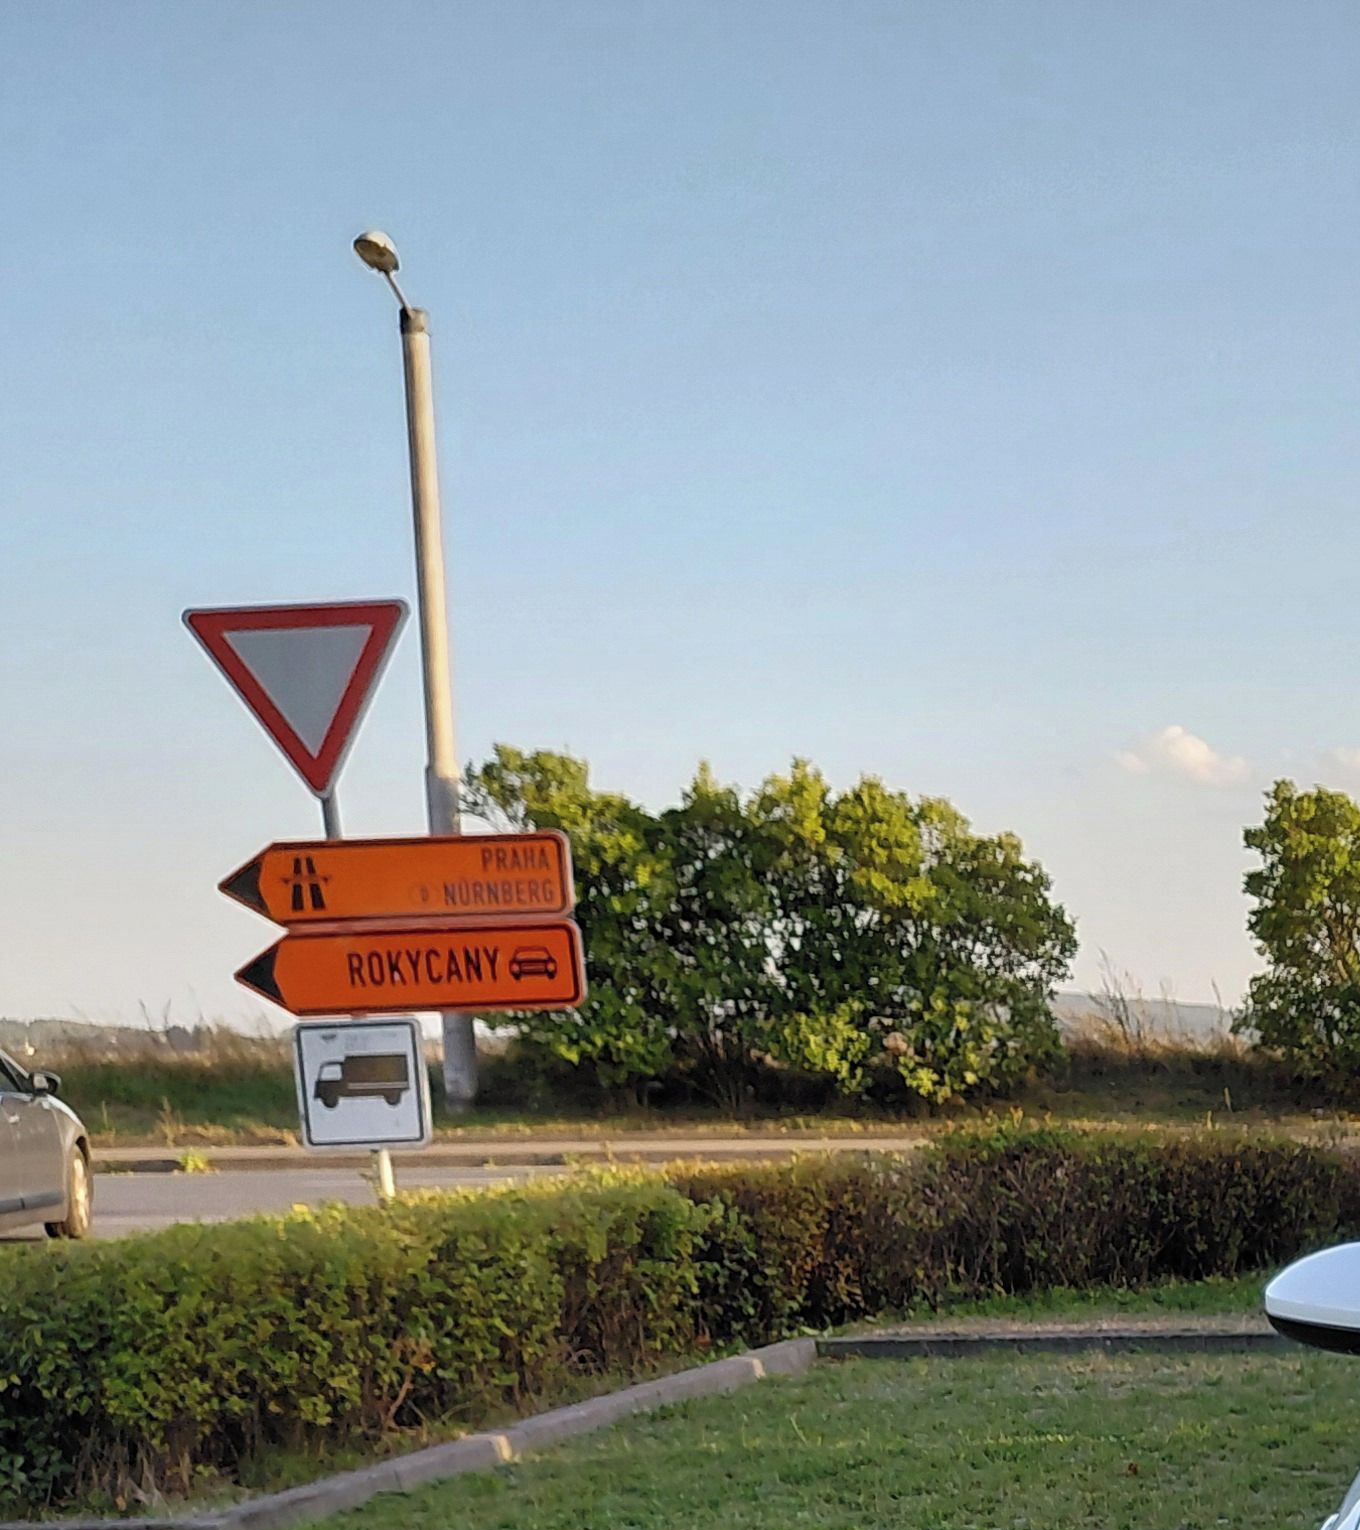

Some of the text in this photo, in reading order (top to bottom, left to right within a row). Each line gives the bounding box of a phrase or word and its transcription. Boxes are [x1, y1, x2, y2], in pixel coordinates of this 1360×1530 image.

[481, 847, 549, 871] PRAHA
[443, 879, 555, 906] NÜRNBERG
[347, 947, 498, 987] ROKYCANY
